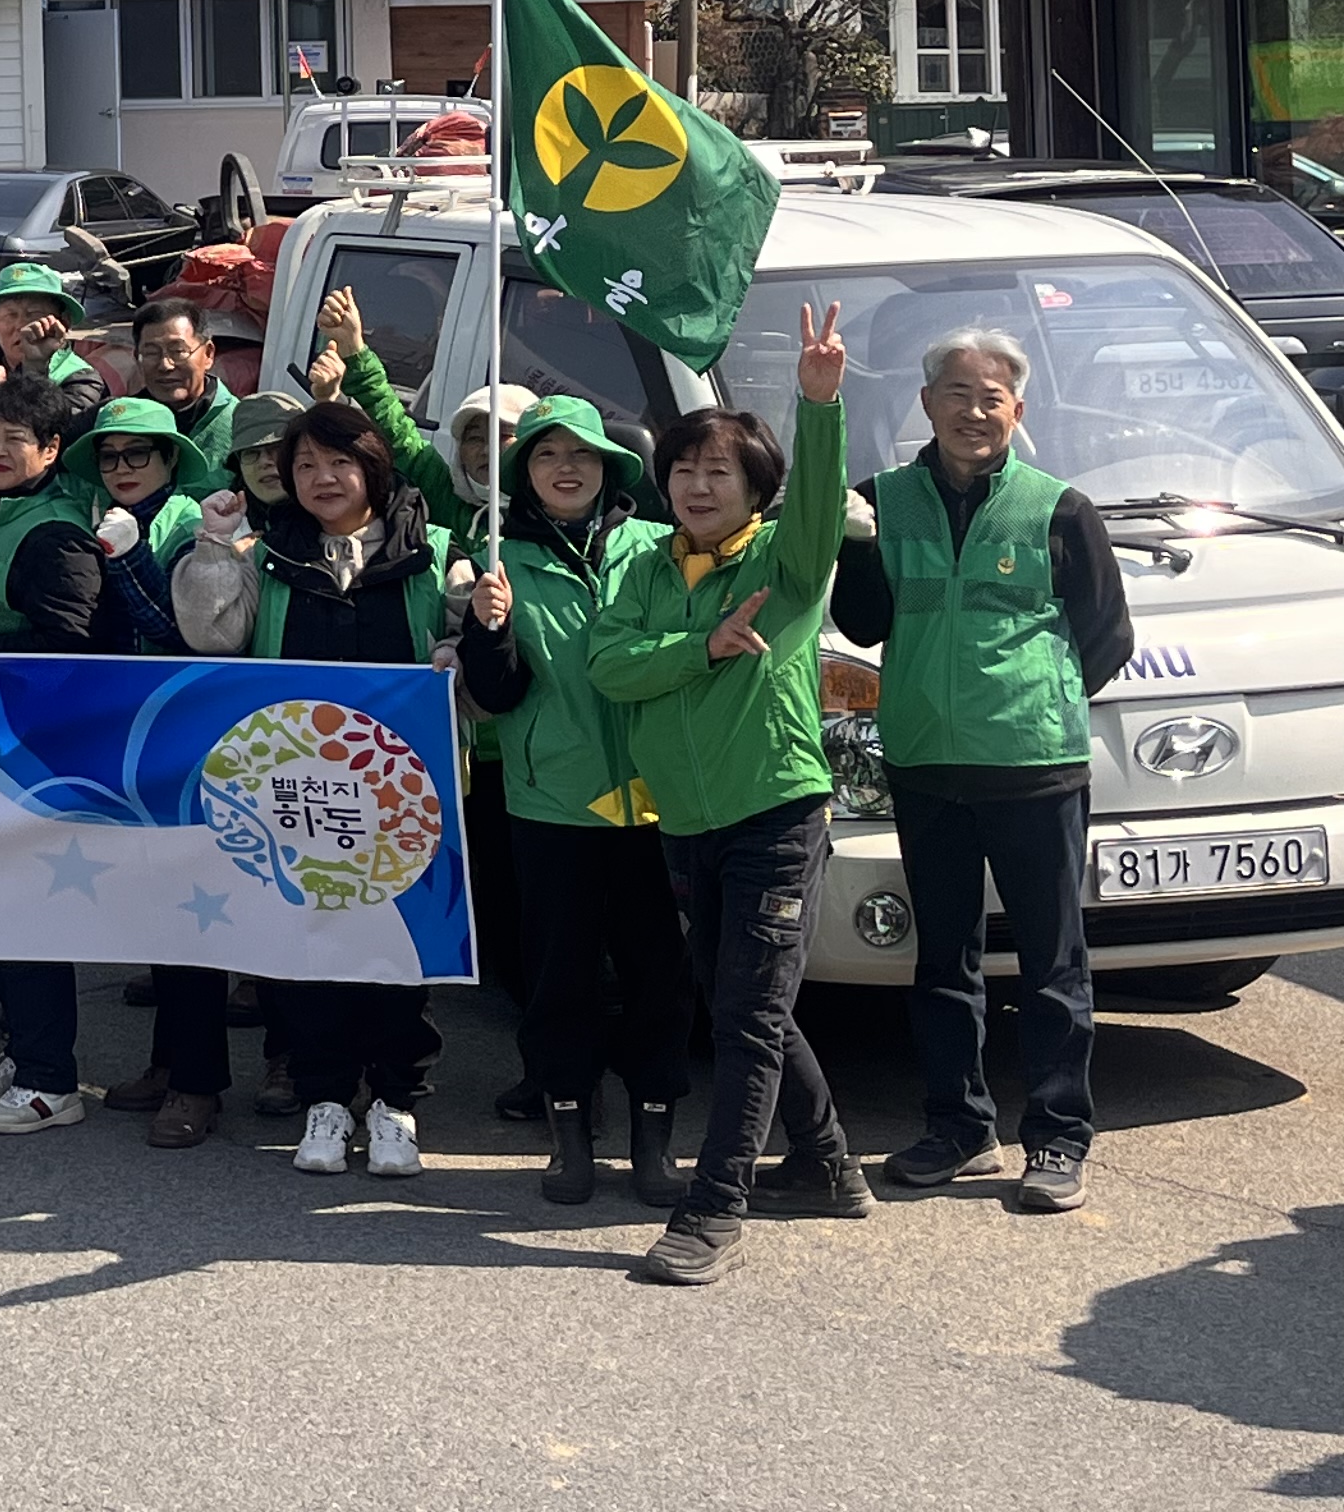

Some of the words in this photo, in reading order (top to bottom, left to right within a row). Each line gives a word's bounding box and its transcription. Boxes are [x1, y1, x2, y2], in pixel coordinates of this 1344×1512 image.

[271, 775, 360, 805] 별천지
[272, 803, 367, 850] 하동
[1118, 848, 1191, 888] 81가
[1209, 837, 1304, 883] 7560
